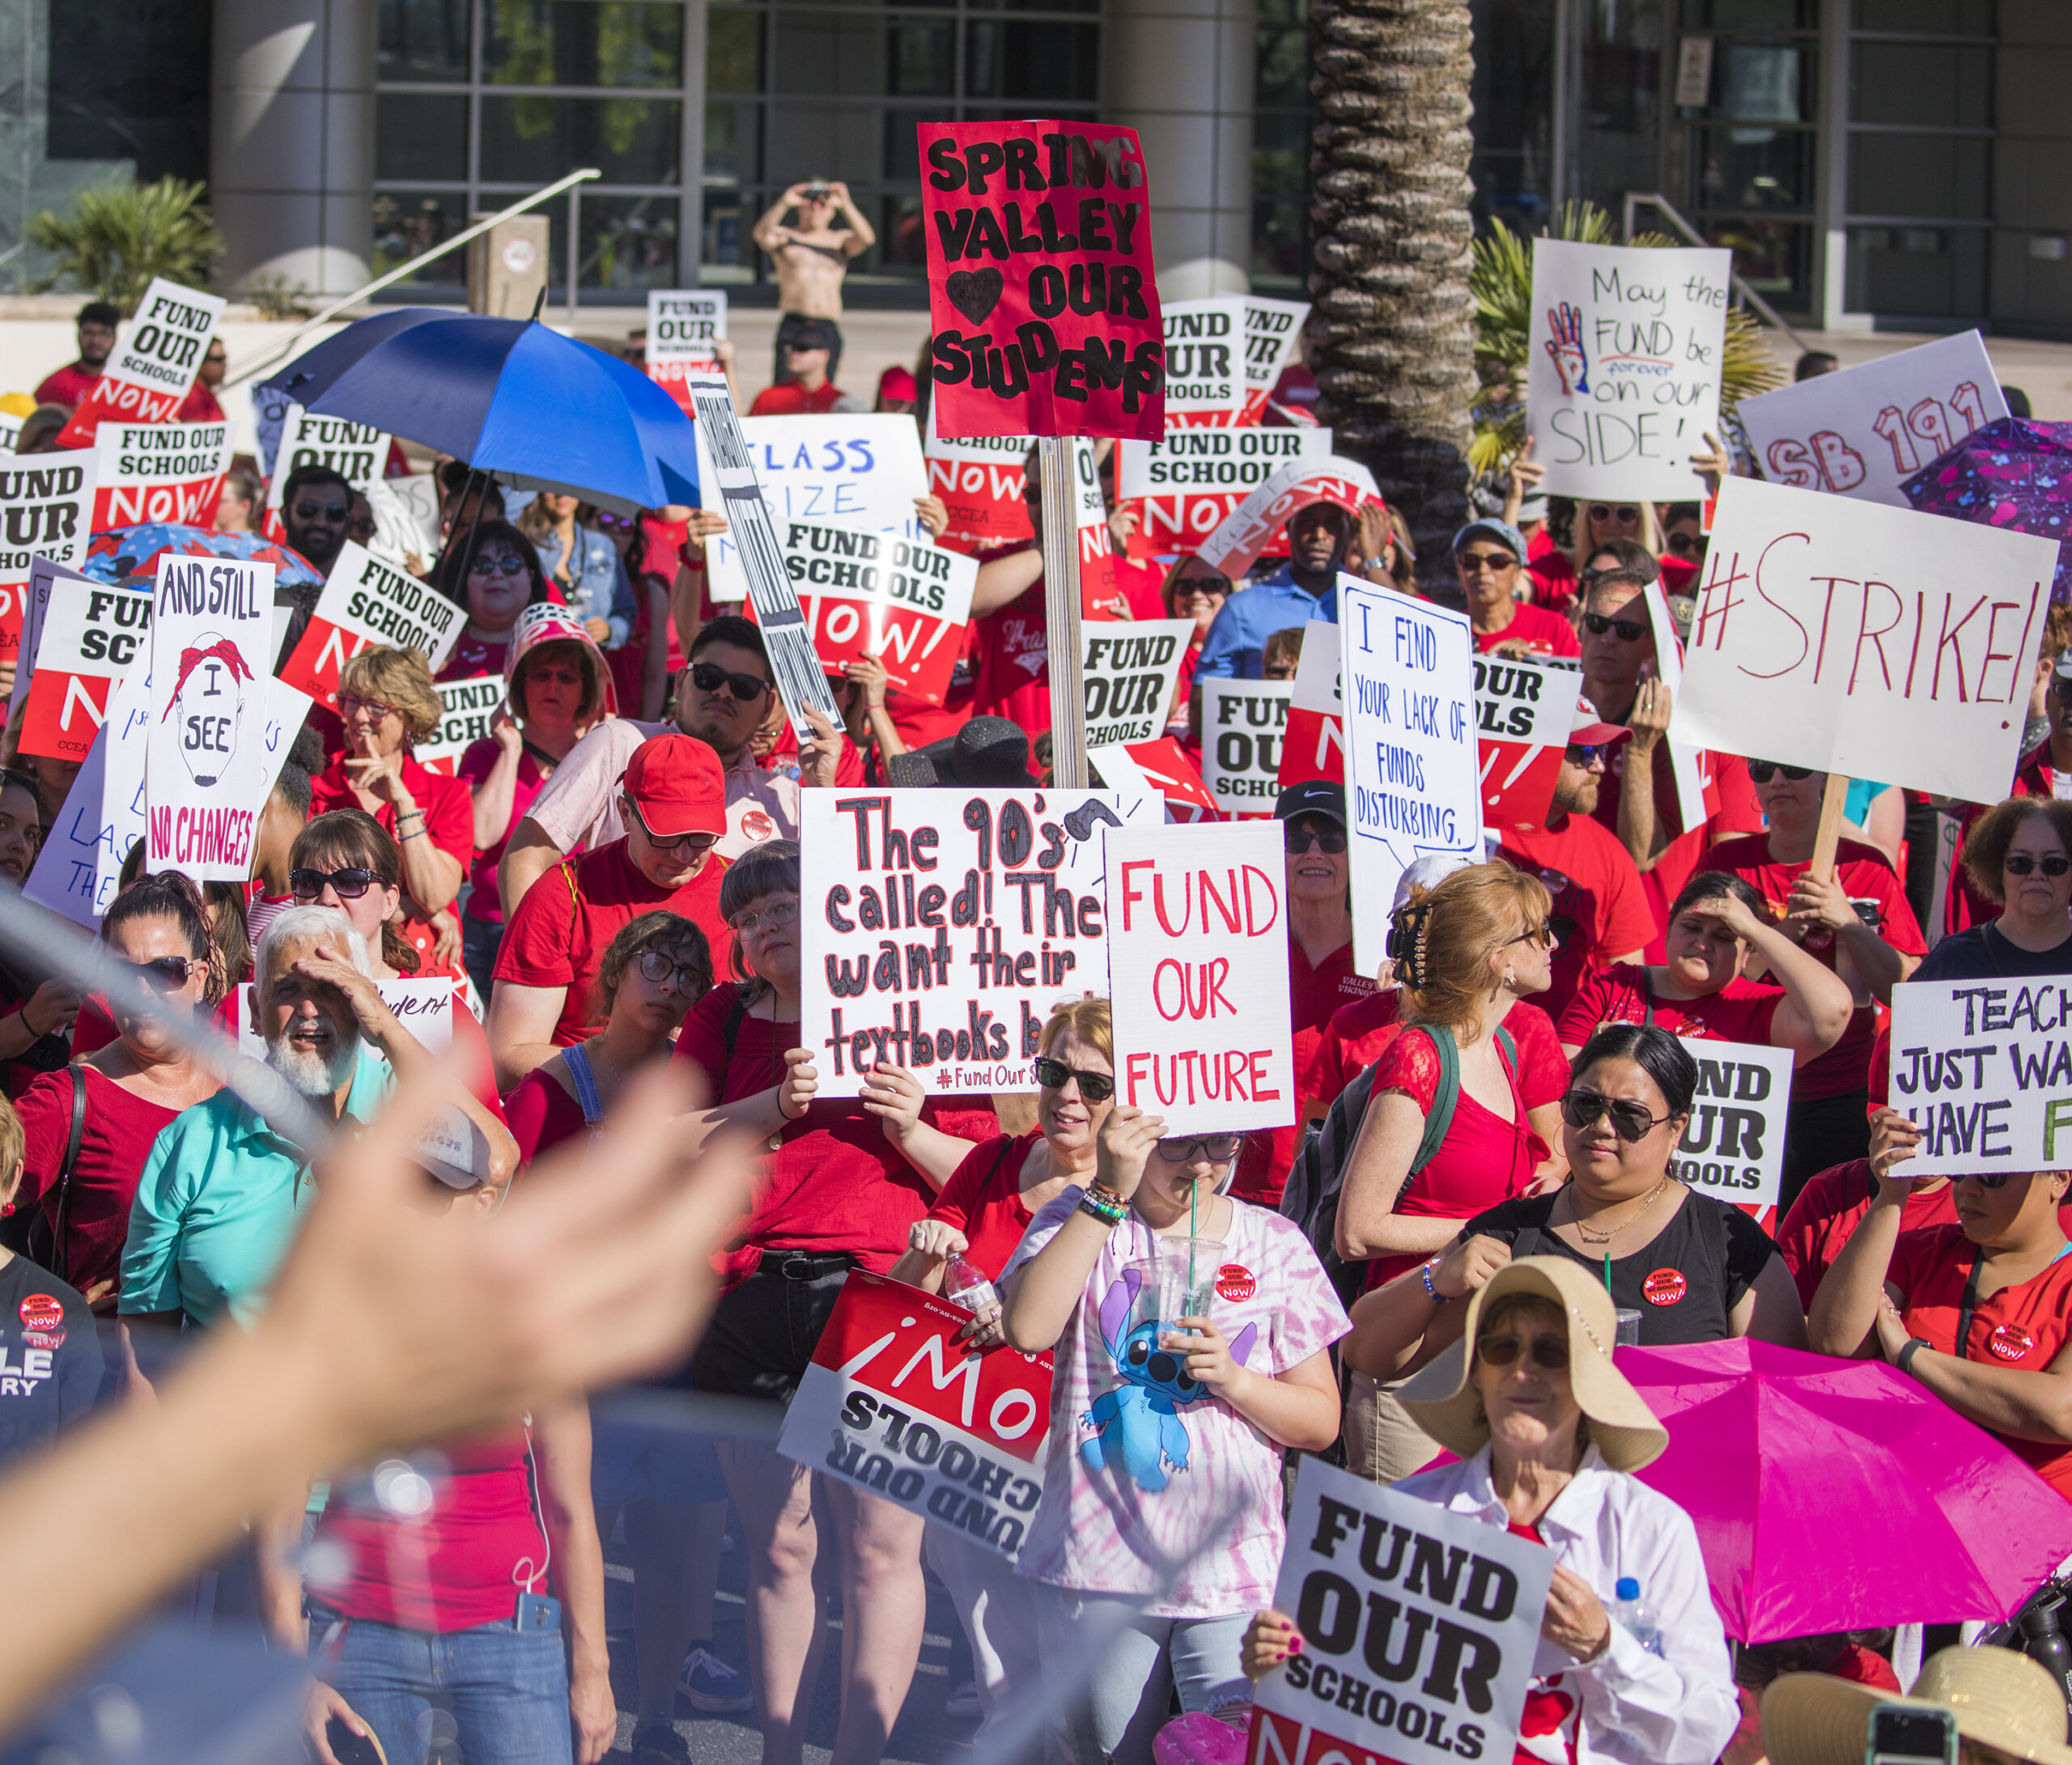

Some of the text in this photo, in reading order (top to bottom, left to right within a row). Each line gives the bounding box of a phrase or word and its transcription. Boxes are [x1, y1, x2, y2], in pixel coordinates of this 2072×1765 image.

[928, 134, 1143, 195] SPRING
[934, 197, 1141, 262] VALLEY
[660, 300, 715, 315] FUND
[1028, 261, 1149, 320] OUR
[1593, 266, 1726, 317] May the
[148, 296, 212, 333] FUND
[659, 320, 715, 339] OUR
[1164, 312, 1231, 339] UND
[133, 325, 201, 368] OUR
[1166, 343, 1230, 378] UR
[1595, 317, 1712, 365] FUND be
[121, 355, 189, 387] SCHOOLS
[932, 320, 1165, 414] STUDENTS
[1607, 361, 1675, 377] forever
[91, 377, 184, 422] NOW!
[1166, 384, 1231, 400] HOOLS
[1594, 380, 1712, 405] on our
[121, 427, 226, 449] FUND OUR
[296, 419, 380, 444] FUND
[942, 436, 1031, 453] CHOOL
[1149, 434, 1301, 456] FUND OUR
[1552, 408, 1685, 466] SIDE!
[1767, 380, 1988, 492] SB 191
[119, 452, 221, 475] SCHOOLS
[746, 439, 875, 473] LASS
[0, 466, 83, 500] UND
[107, 473, 222, 526] NOW!
[930, 459, 1030, 503] NOW
[0, 502, 79, 545] UR
[787, 523, 882, 560] FUND
[892, 540, 952, 582] OUR
[159, 562, 260, 620] AND STILL
[359, 559, 454, 635] FUND OUR
[785, 555, 947, 612] SCHOOLS
[86, 591, 152, 630] FU
[346, 592, 439, 660] SCHOOLS
[1696, 532, 2040, 730] #STRIKE!
[1084, 635, 1177, 671] FUND
[1357, 603, 1437, 672] I FIND
[202, 664, 222, 697] I
[442, 684, 499, 713] UND
[1084, 672, 1165, 720] OUR
[1218, 695, 1290, 727] FUN
[1355, 673, 1391, 724] YOUR
[1403, 688, 1440, 738] LACK
[1450, 700, 1467, 745] OF
[58, 740, 88, 753] CCEA
[185, 715, 231, 753] SEE
[1086, 720, 1153, 745] CHOOLS
[1217, 732, 1285, 773] OU
[1216, 777, 1280, 798] SCHO
[1376, 742, 1424, 792] FUNDS
[70, 807, 137, 865] LAS
[151, 805, 253, 867] NO CHANGES
[836, 792, 1066, 872] The 90's
[1357, 785, 1462, 845] DISTURBING.
[67, 860, 115, 905] THE
[825, 868, 1106, 939] called! The
[1121, 859, 1278, 938] FUND
[824, 926, 1076, 999] want their
[1343, 976, 1374, 990] VALLEY
[380, 990, 448, 1018] dent
[1153, 957, 1238, 1021] OUR
[825, 999, 1009, 1077] textbooks
[936, 1066, 991, 1088] #Fund
[995, 1064, 1027, 1086] Our
[1127, 1049, 1281, 1108] FUTURE
[1696, 1059, 1772, 1101] ND
[1896, 1041, 2072, 1094] JUST WA
[1685, 1104, 1766, 1160] UR
[1909, 1099, 2012, 1157] HAVE
[1684, 1160, 1760, 1190] OOLS
[1224, 1286, 1254, 1297] NOW!
[1648, 1283, 1682, 1292] SCHOOLS
[1651, 1288, 1683, 1304] NOW!
[29, 1314, 61, 1326] NOW!
[0, 1347, 53, 1379] LE
[1992, 1342, 2025, 1360] NOW!
[1, 1377, 39, 1397] RY
[840, 1390, 1042, 1513] CHOOLS
[926, 1486, 1025, 1555] UND
[1310, 1494, 1518, 1623] FUND
[1297, 1570, 1501, 1715] OUR
[1285, 1654, 1486, 1760] SCHOOLS
